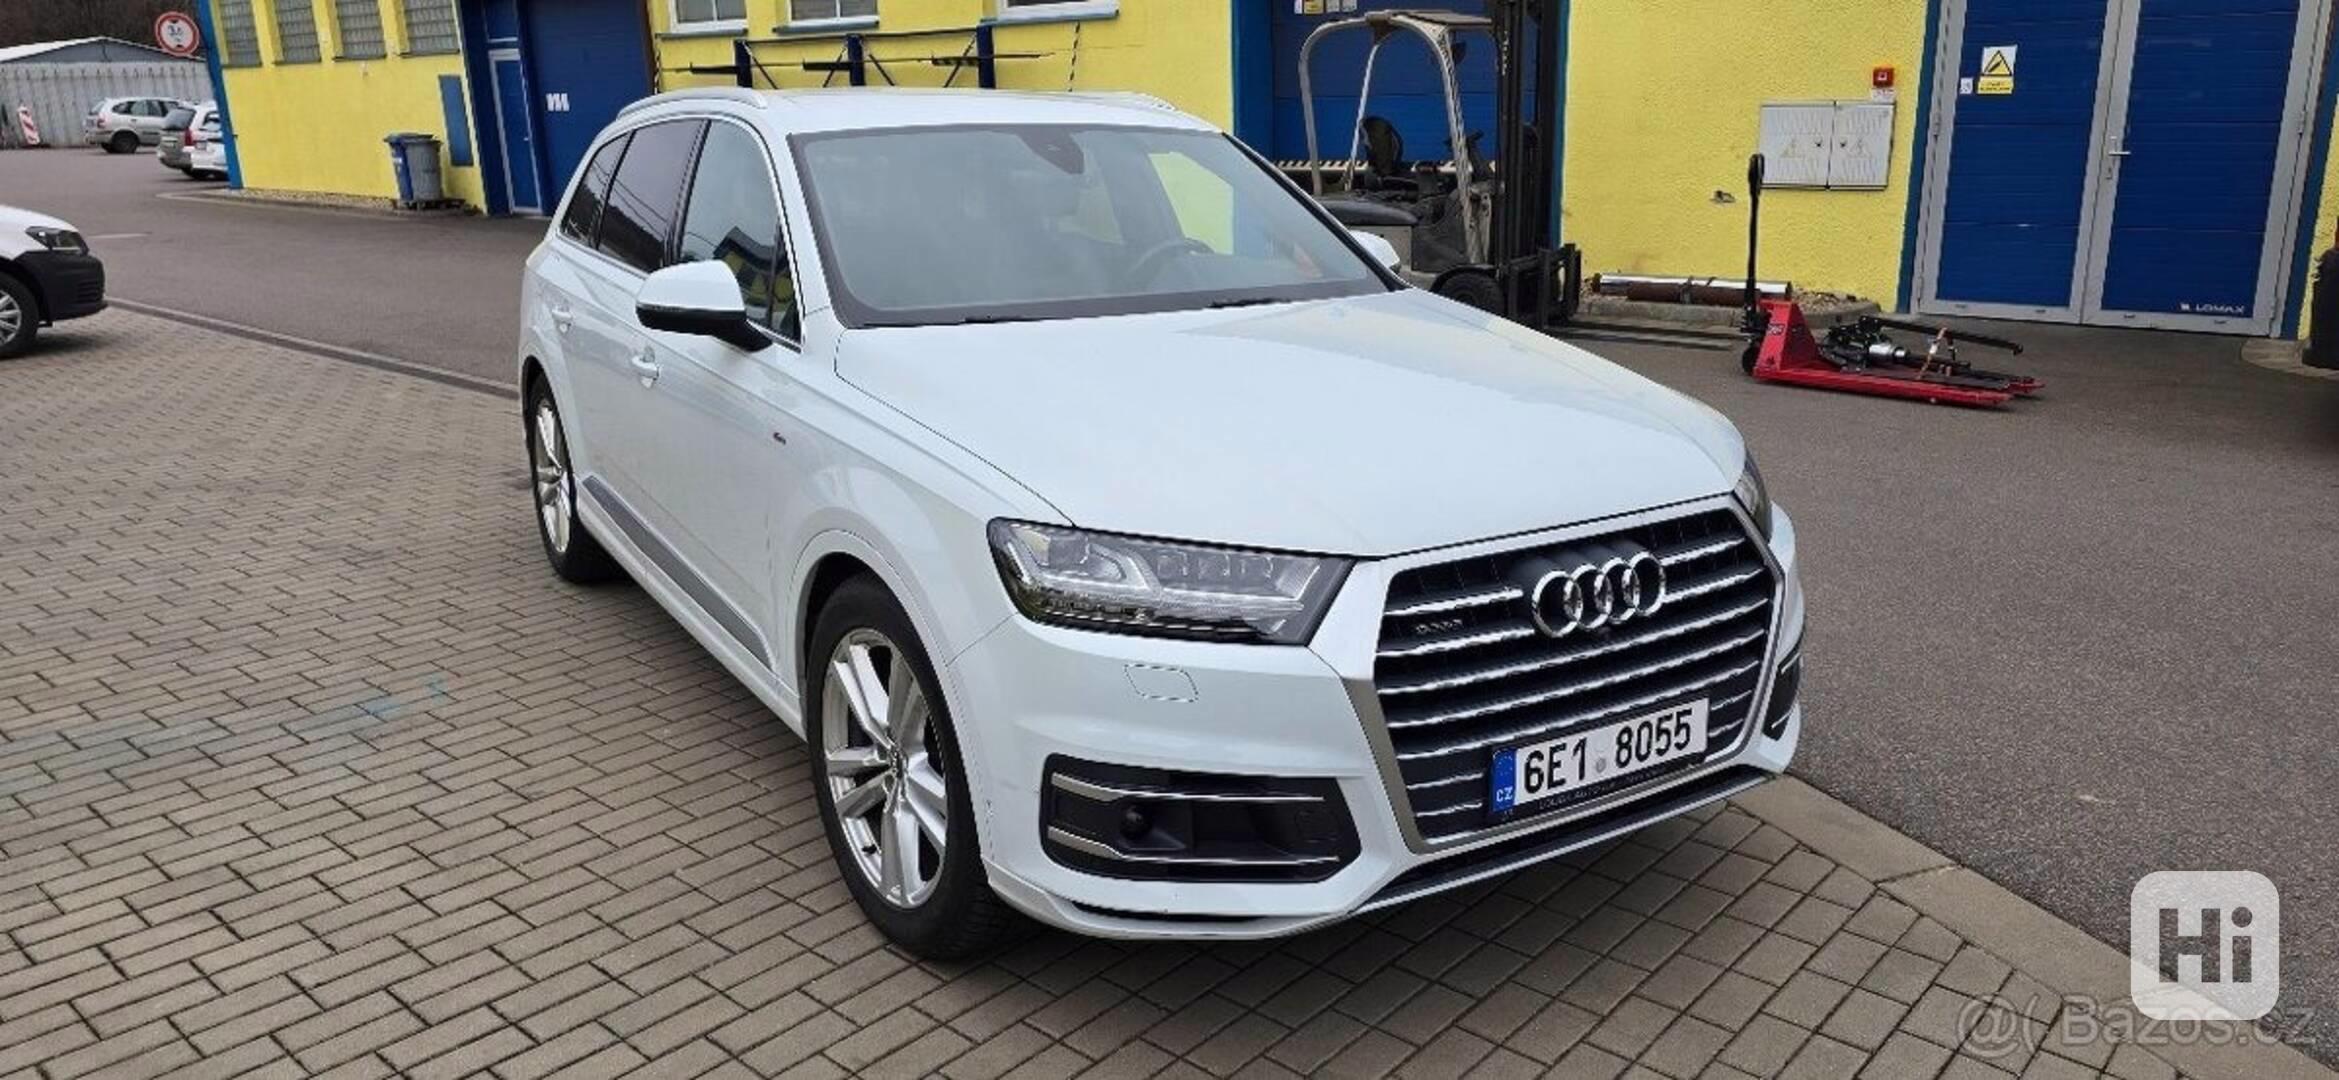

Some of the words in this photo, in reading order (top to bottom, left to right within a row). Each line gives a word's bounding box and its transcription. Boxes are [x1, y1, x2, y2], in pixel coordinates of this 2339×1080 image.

[1524, 737, 1587, 794] 6E1
[1615, 708, 1692, 769] 8055
[1496, 786, 1513, 802] CZ
